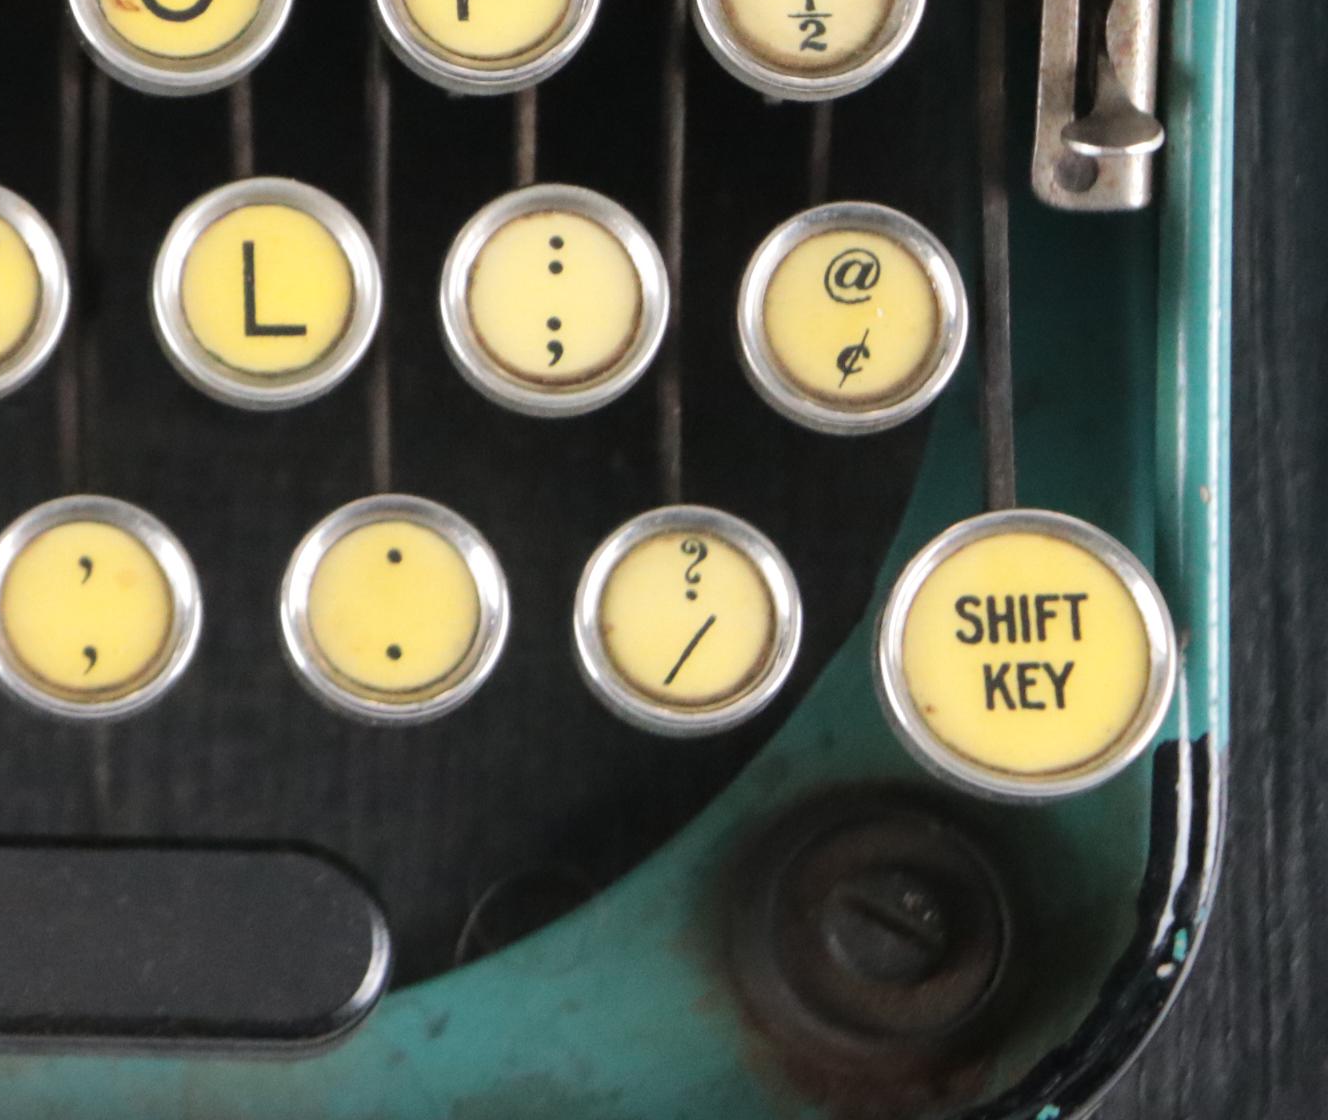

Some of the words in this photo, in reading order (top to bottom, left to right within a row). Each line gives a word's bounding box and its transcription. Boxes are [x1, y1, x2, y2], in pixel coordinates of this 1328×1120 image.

[243, 241, 307, 337] L
[824, 249, 881, 305] @
[680, 537, 709, 602] ?
[955, 593, 1087, 645] SHIFT
[663, 614, 717, 686] /
[983, 662, 1074, 711] KEY
